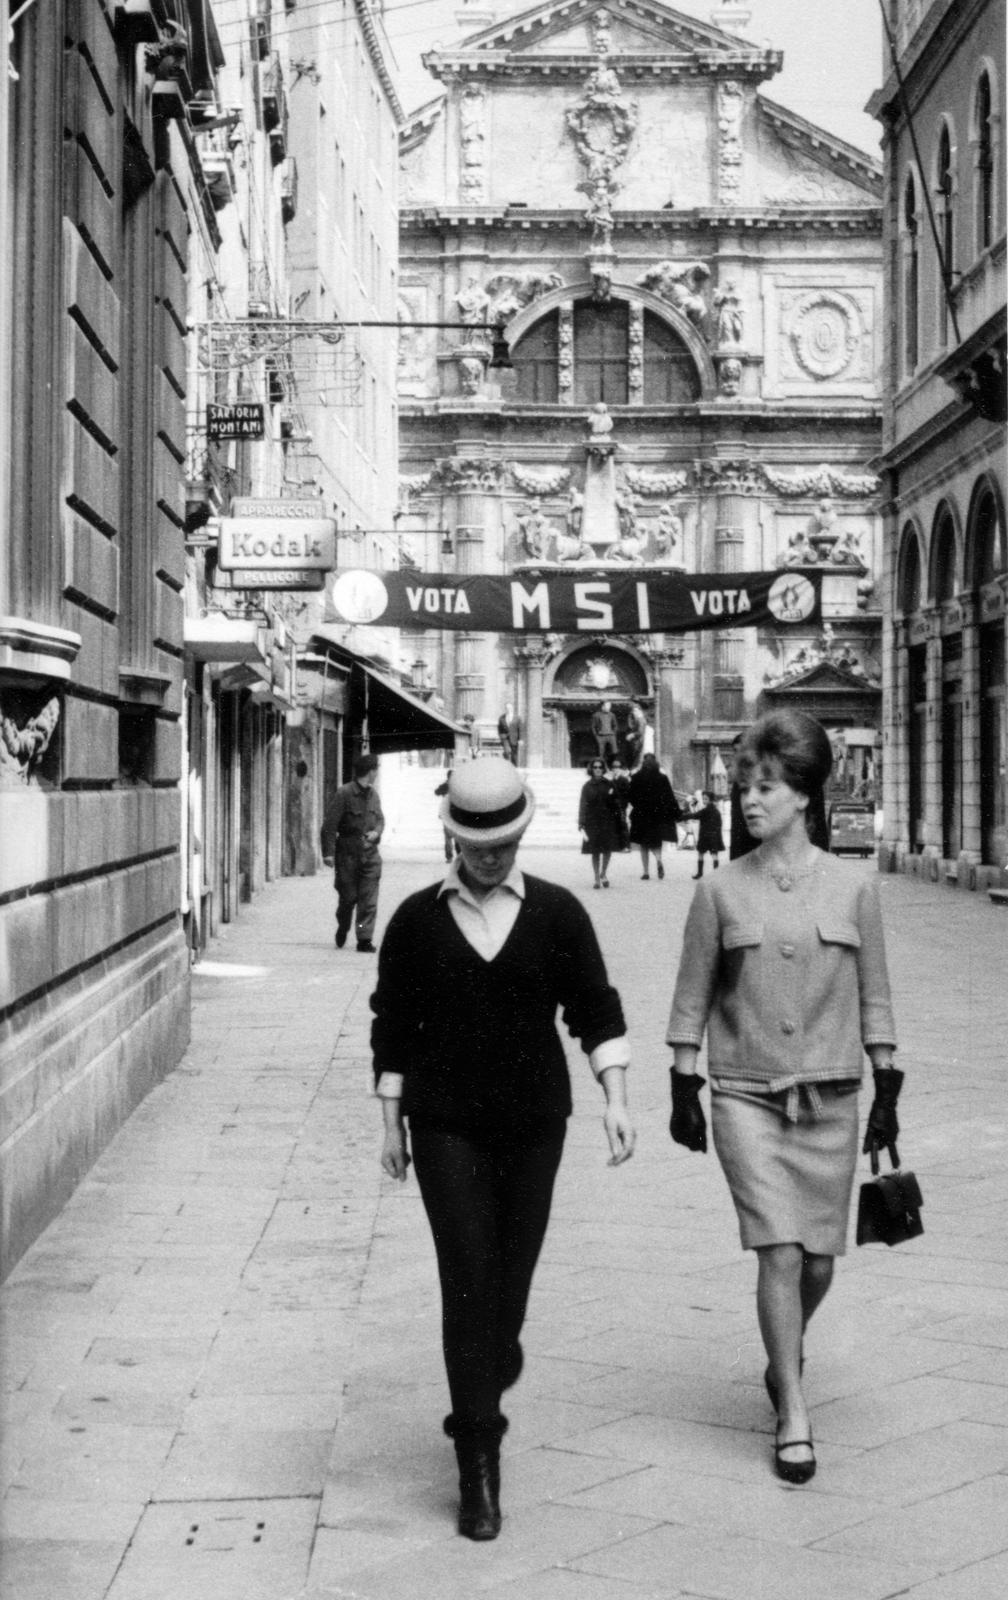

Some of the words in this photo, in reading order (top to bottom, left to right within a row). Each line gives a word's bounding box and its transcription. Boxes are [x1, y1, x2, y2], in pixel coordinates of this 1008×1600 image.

[211, 407, 260, 419] SARTORIA
[241, 505, 315, 518] APPARECCHI
[231, 533, 322, 557] Kodak
[244, 571, 310, 583] PELLICOLE
[405, 586, 471, 614] VOTA
[689, 588, 752, 617] VOTA
